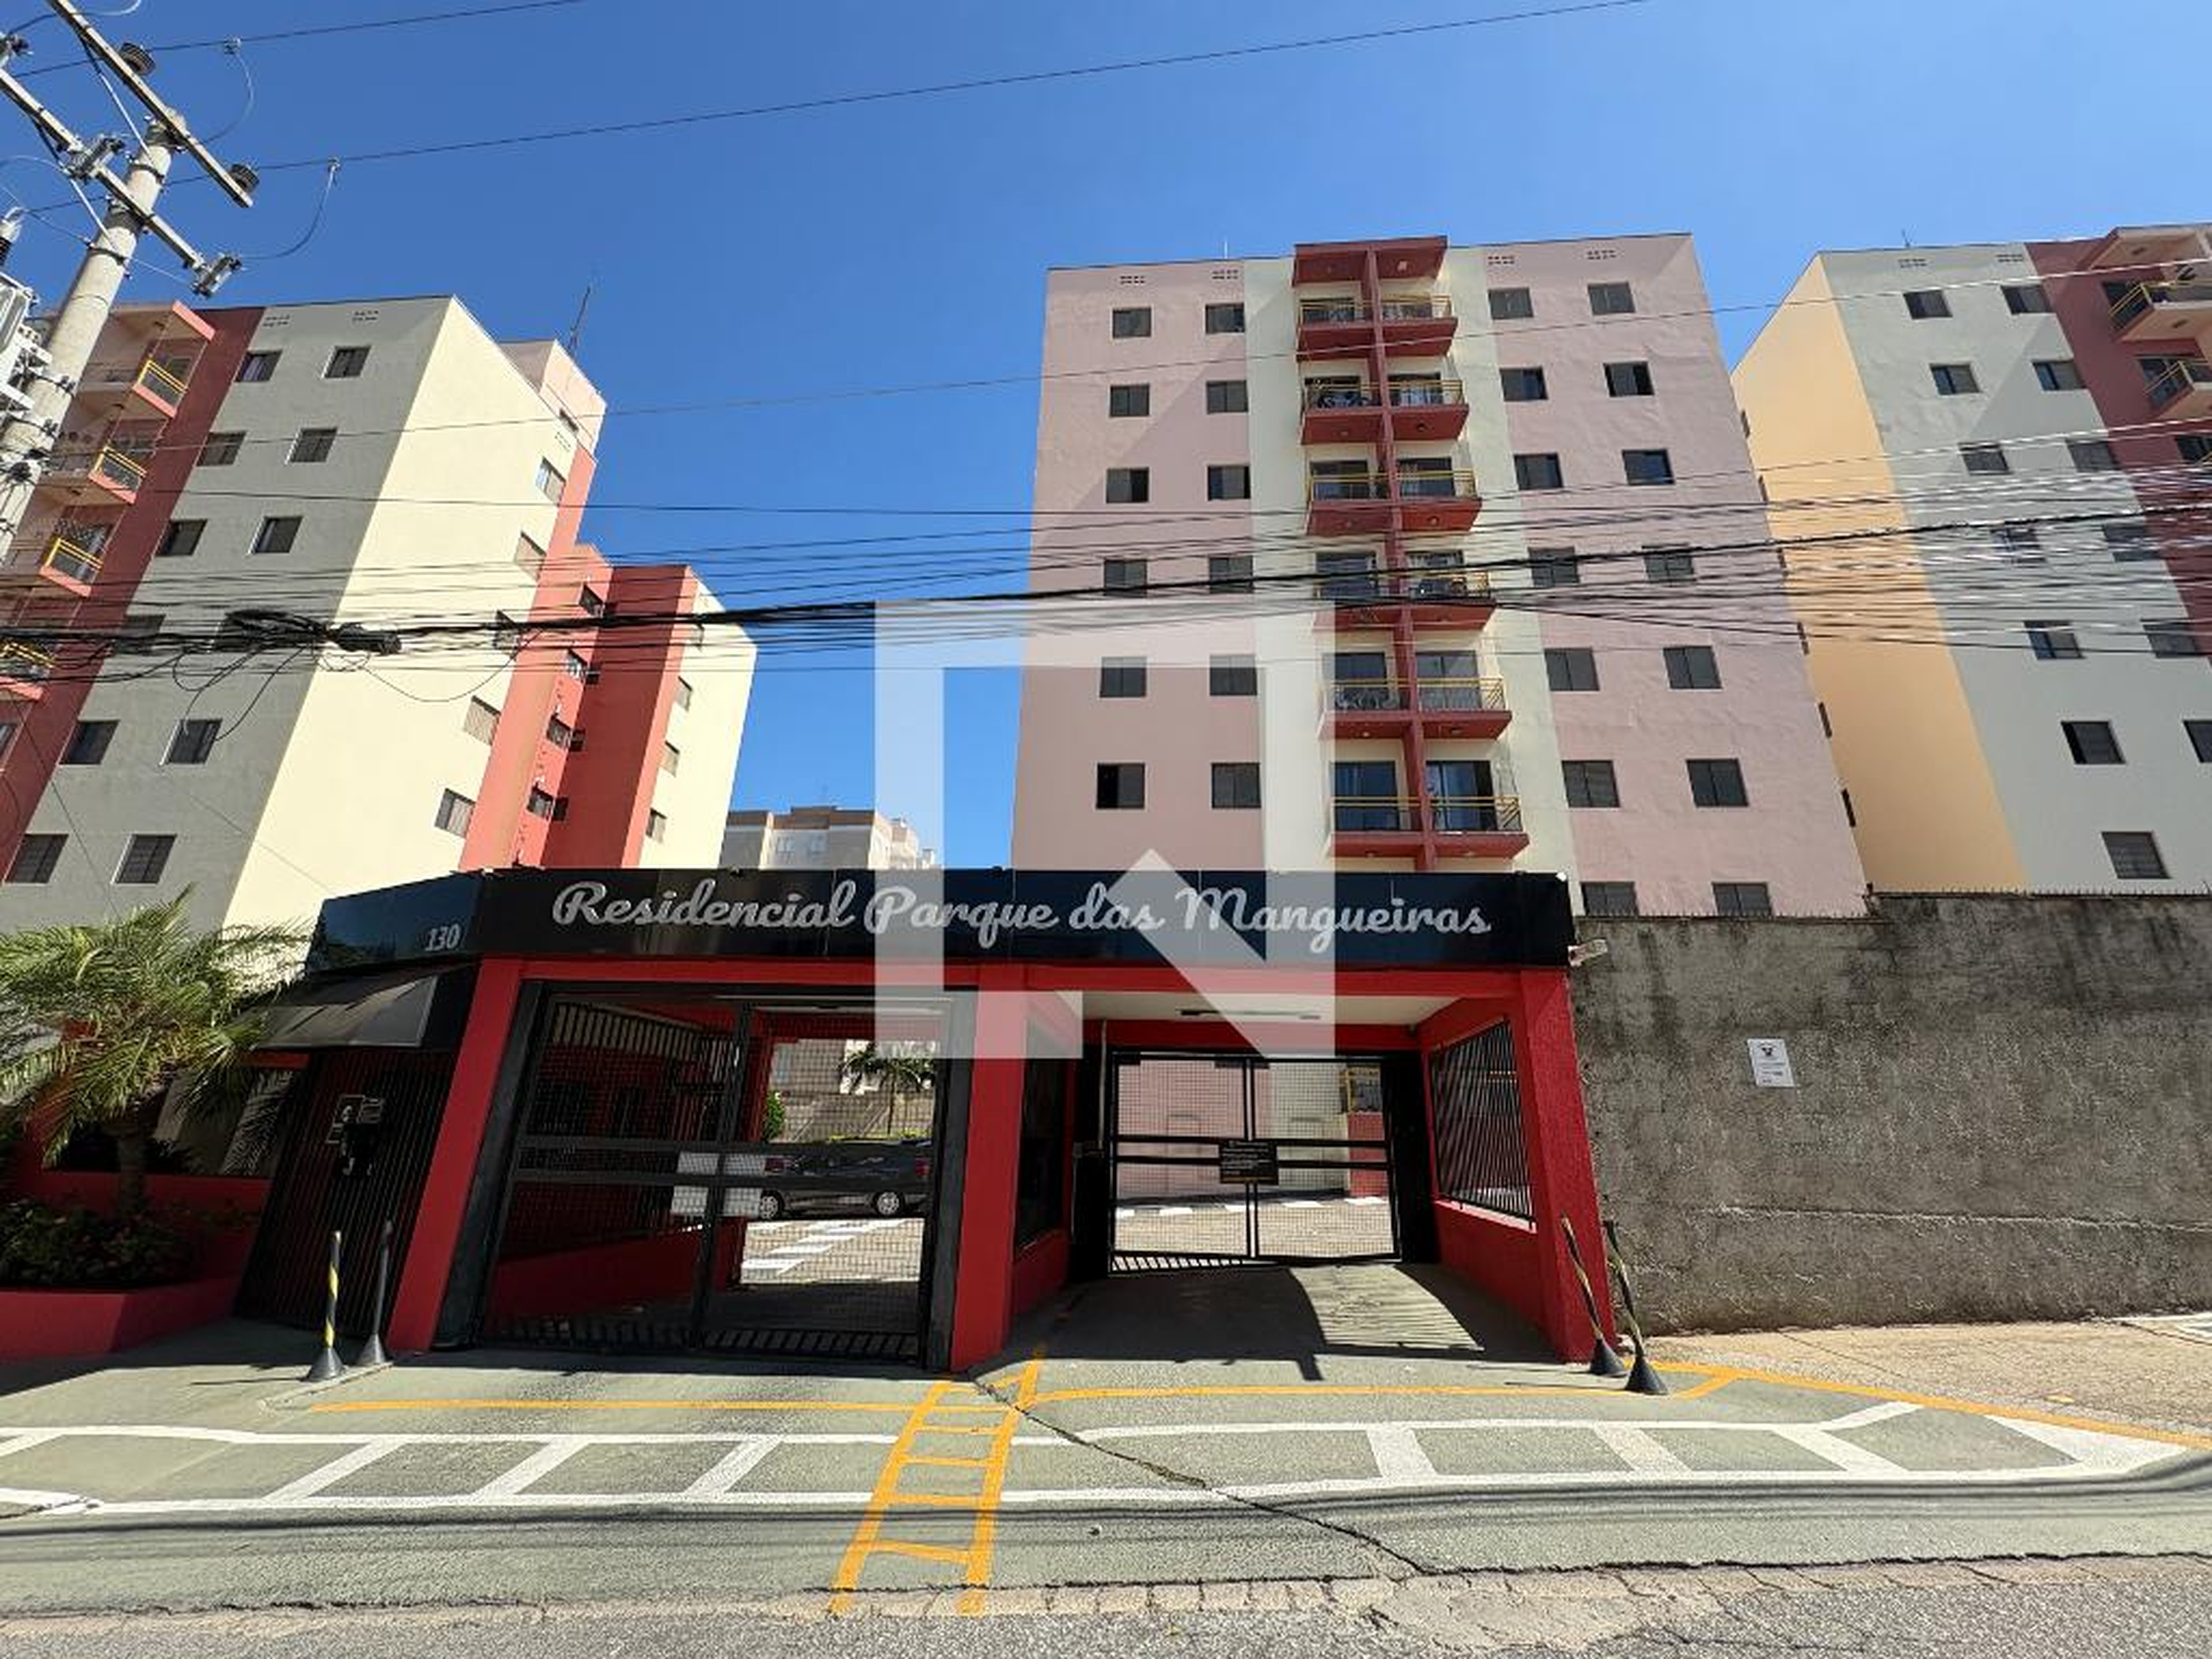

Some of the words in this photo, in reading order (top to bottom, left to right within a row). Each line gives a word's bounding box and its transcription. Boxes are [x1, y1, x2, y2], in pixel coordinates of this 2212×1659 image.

[425, 923, 460, 952] 130
[552, 878, 857, 927] Residencial
[865, 885, 1059, 949] Parque
[1069, 881, 1166, 930] das
[1175, 887, 1491, 953] Mangueiras
